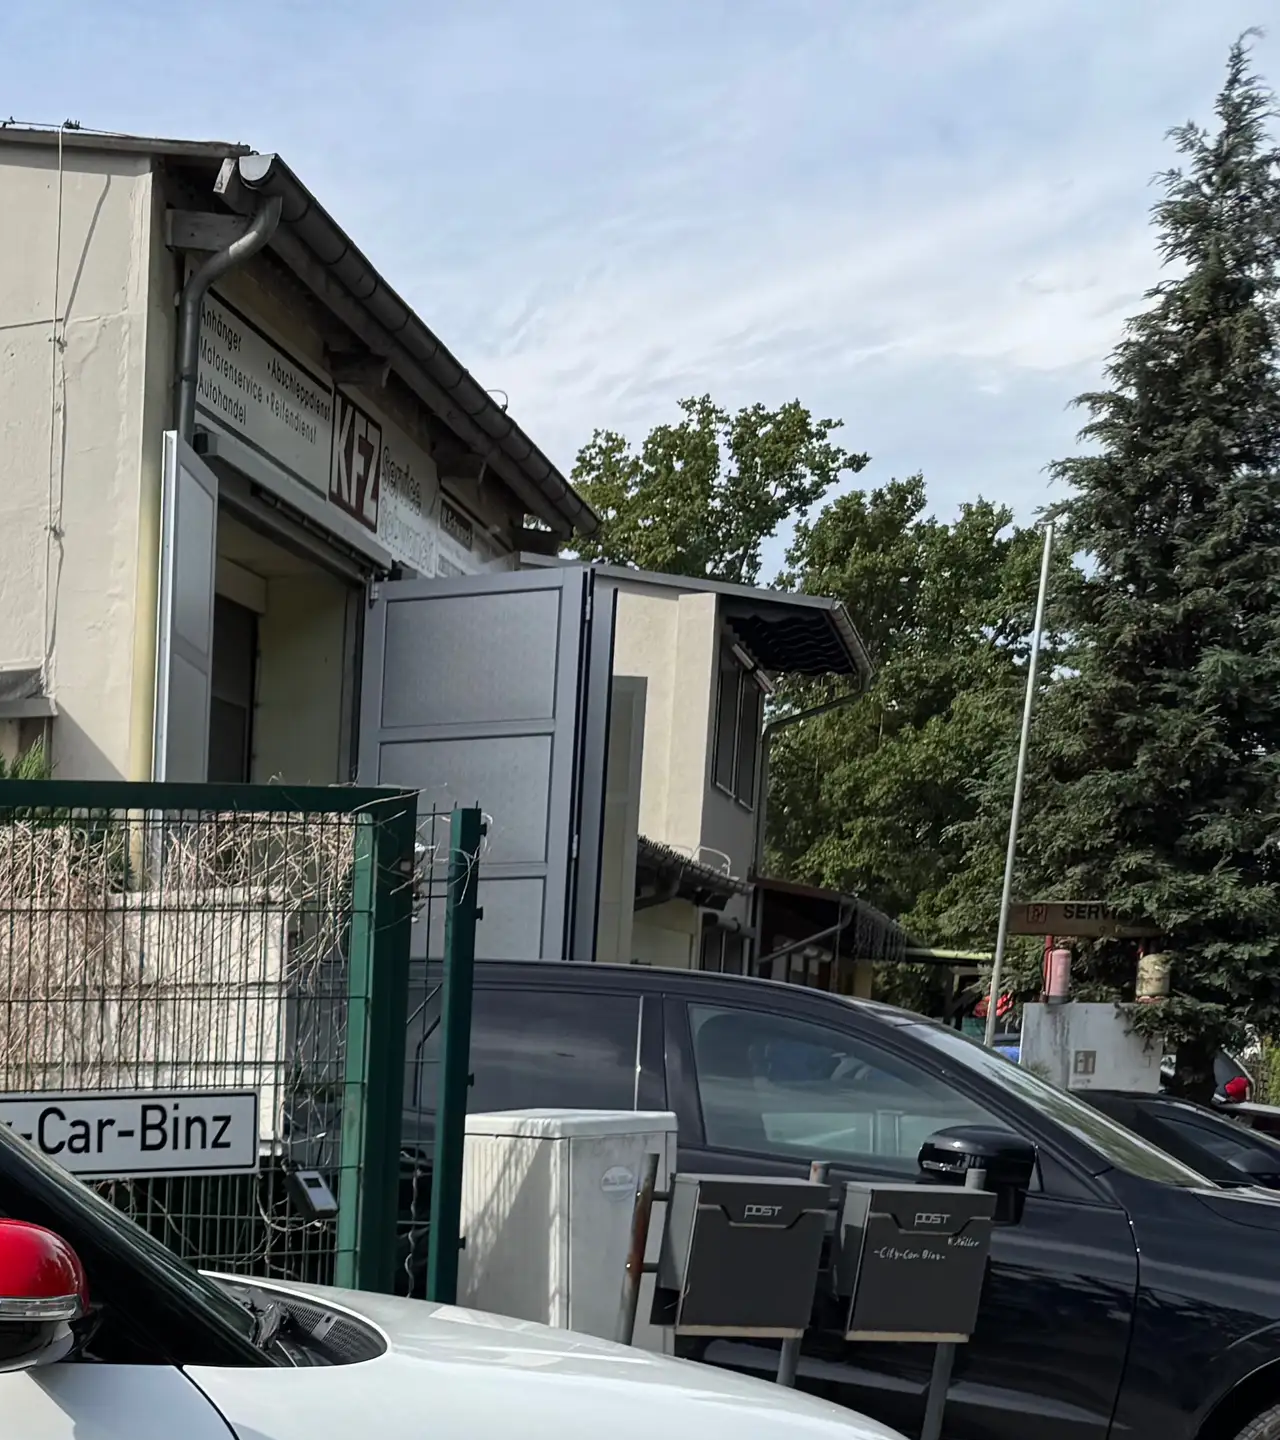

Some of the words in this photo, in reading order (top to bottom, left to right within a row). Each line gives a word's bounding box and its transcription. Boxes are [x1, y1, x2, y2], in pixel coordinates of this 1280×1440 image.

[200, 301, 242, 352] Anhänger
[271, 357, 331, 422] Abschleppdienst
[200, 336, 262, 403] Motorenservice
[198, 372, 248, 425] Autohandel
[331, 393, 381, 527] KFZ
[7, 1102, 232, 1156] -Car-Binz
[742, 1203, 783, 1219] POST
[913, 1211, 951, 1226] POST
